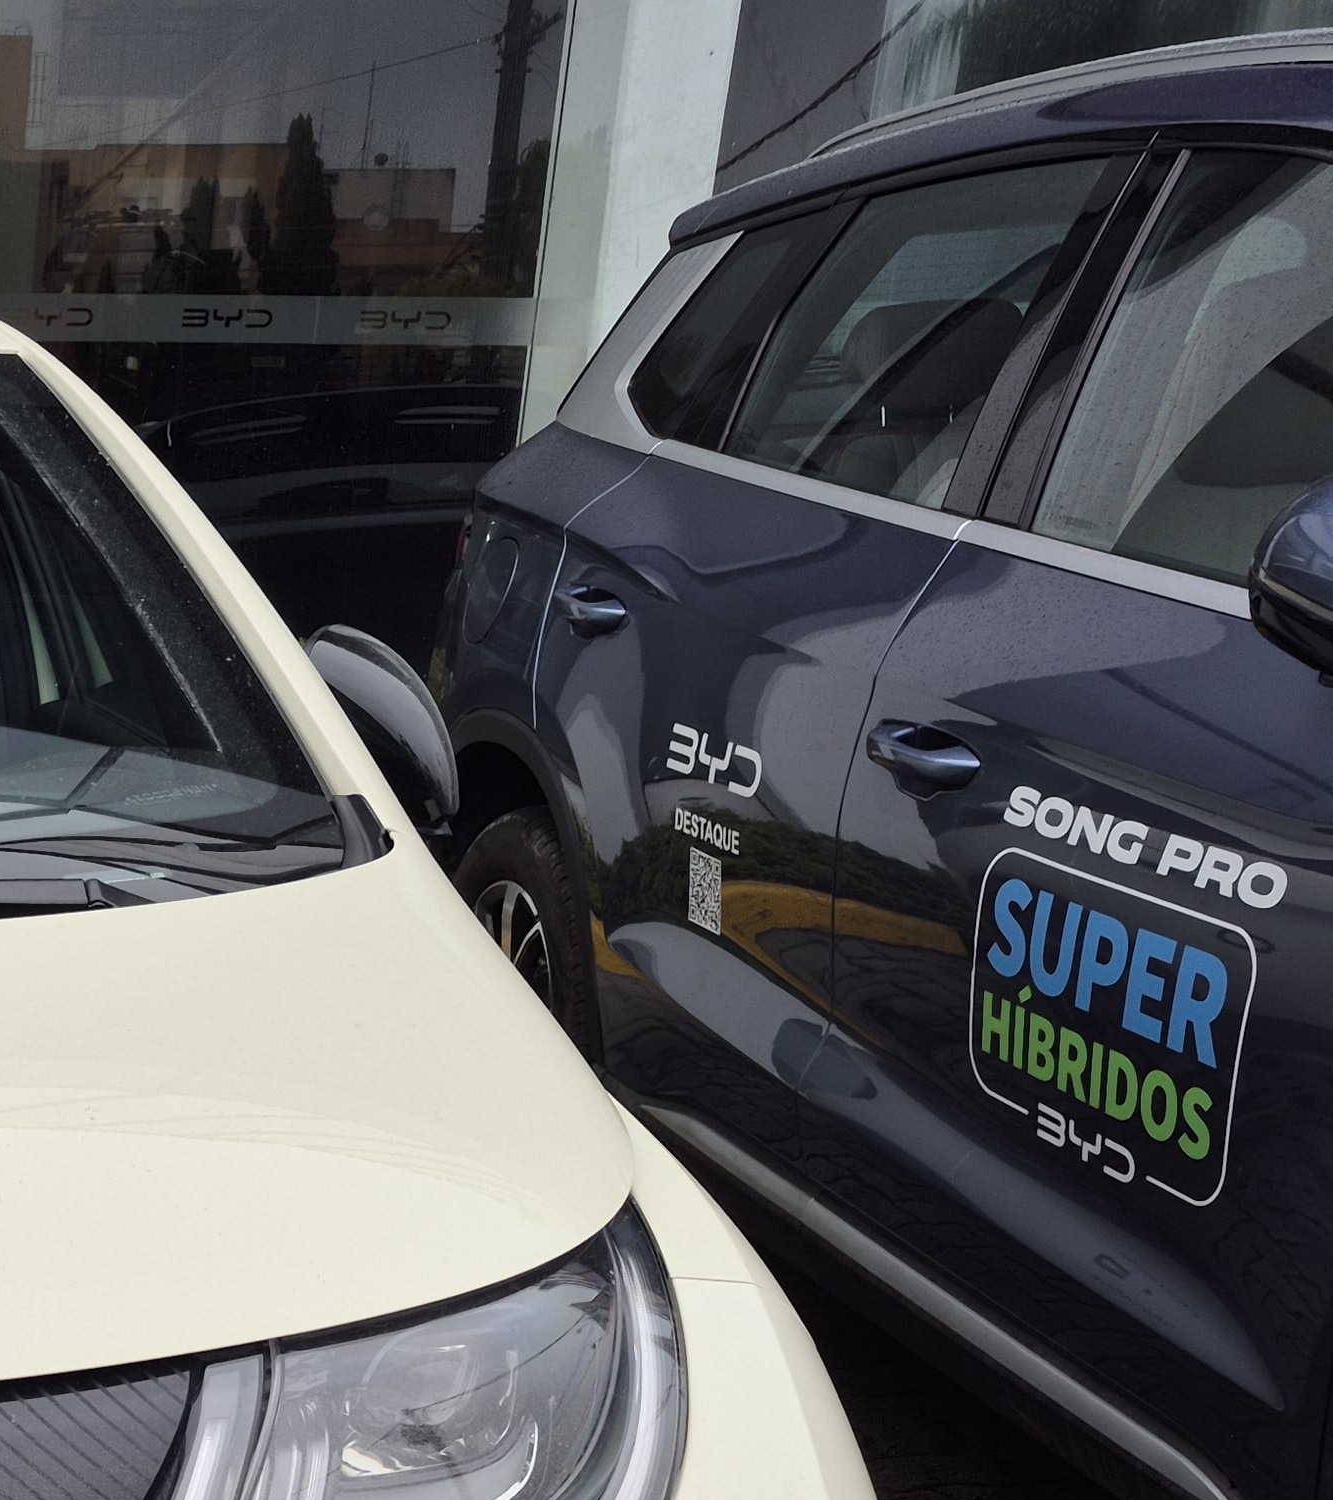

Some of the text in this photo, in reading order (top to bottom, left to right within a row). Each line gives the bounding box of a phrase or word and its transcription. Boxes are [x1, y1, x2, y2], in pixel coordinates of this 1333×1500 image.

[181, 308, 271, 328] BYD
[360, 311, 451, 330] BYD
[667, 723, 763, 799] BYD
[674, 807, 741, 856] DESTAQUE
[1003, 785, 1289, 910] SONG PRO
[986, 878, 1229, 1069] SUPER
[981, 985, 1214, 1161] HÍBRIDOS
[1036, 1104, 1136, 1184] BYD
